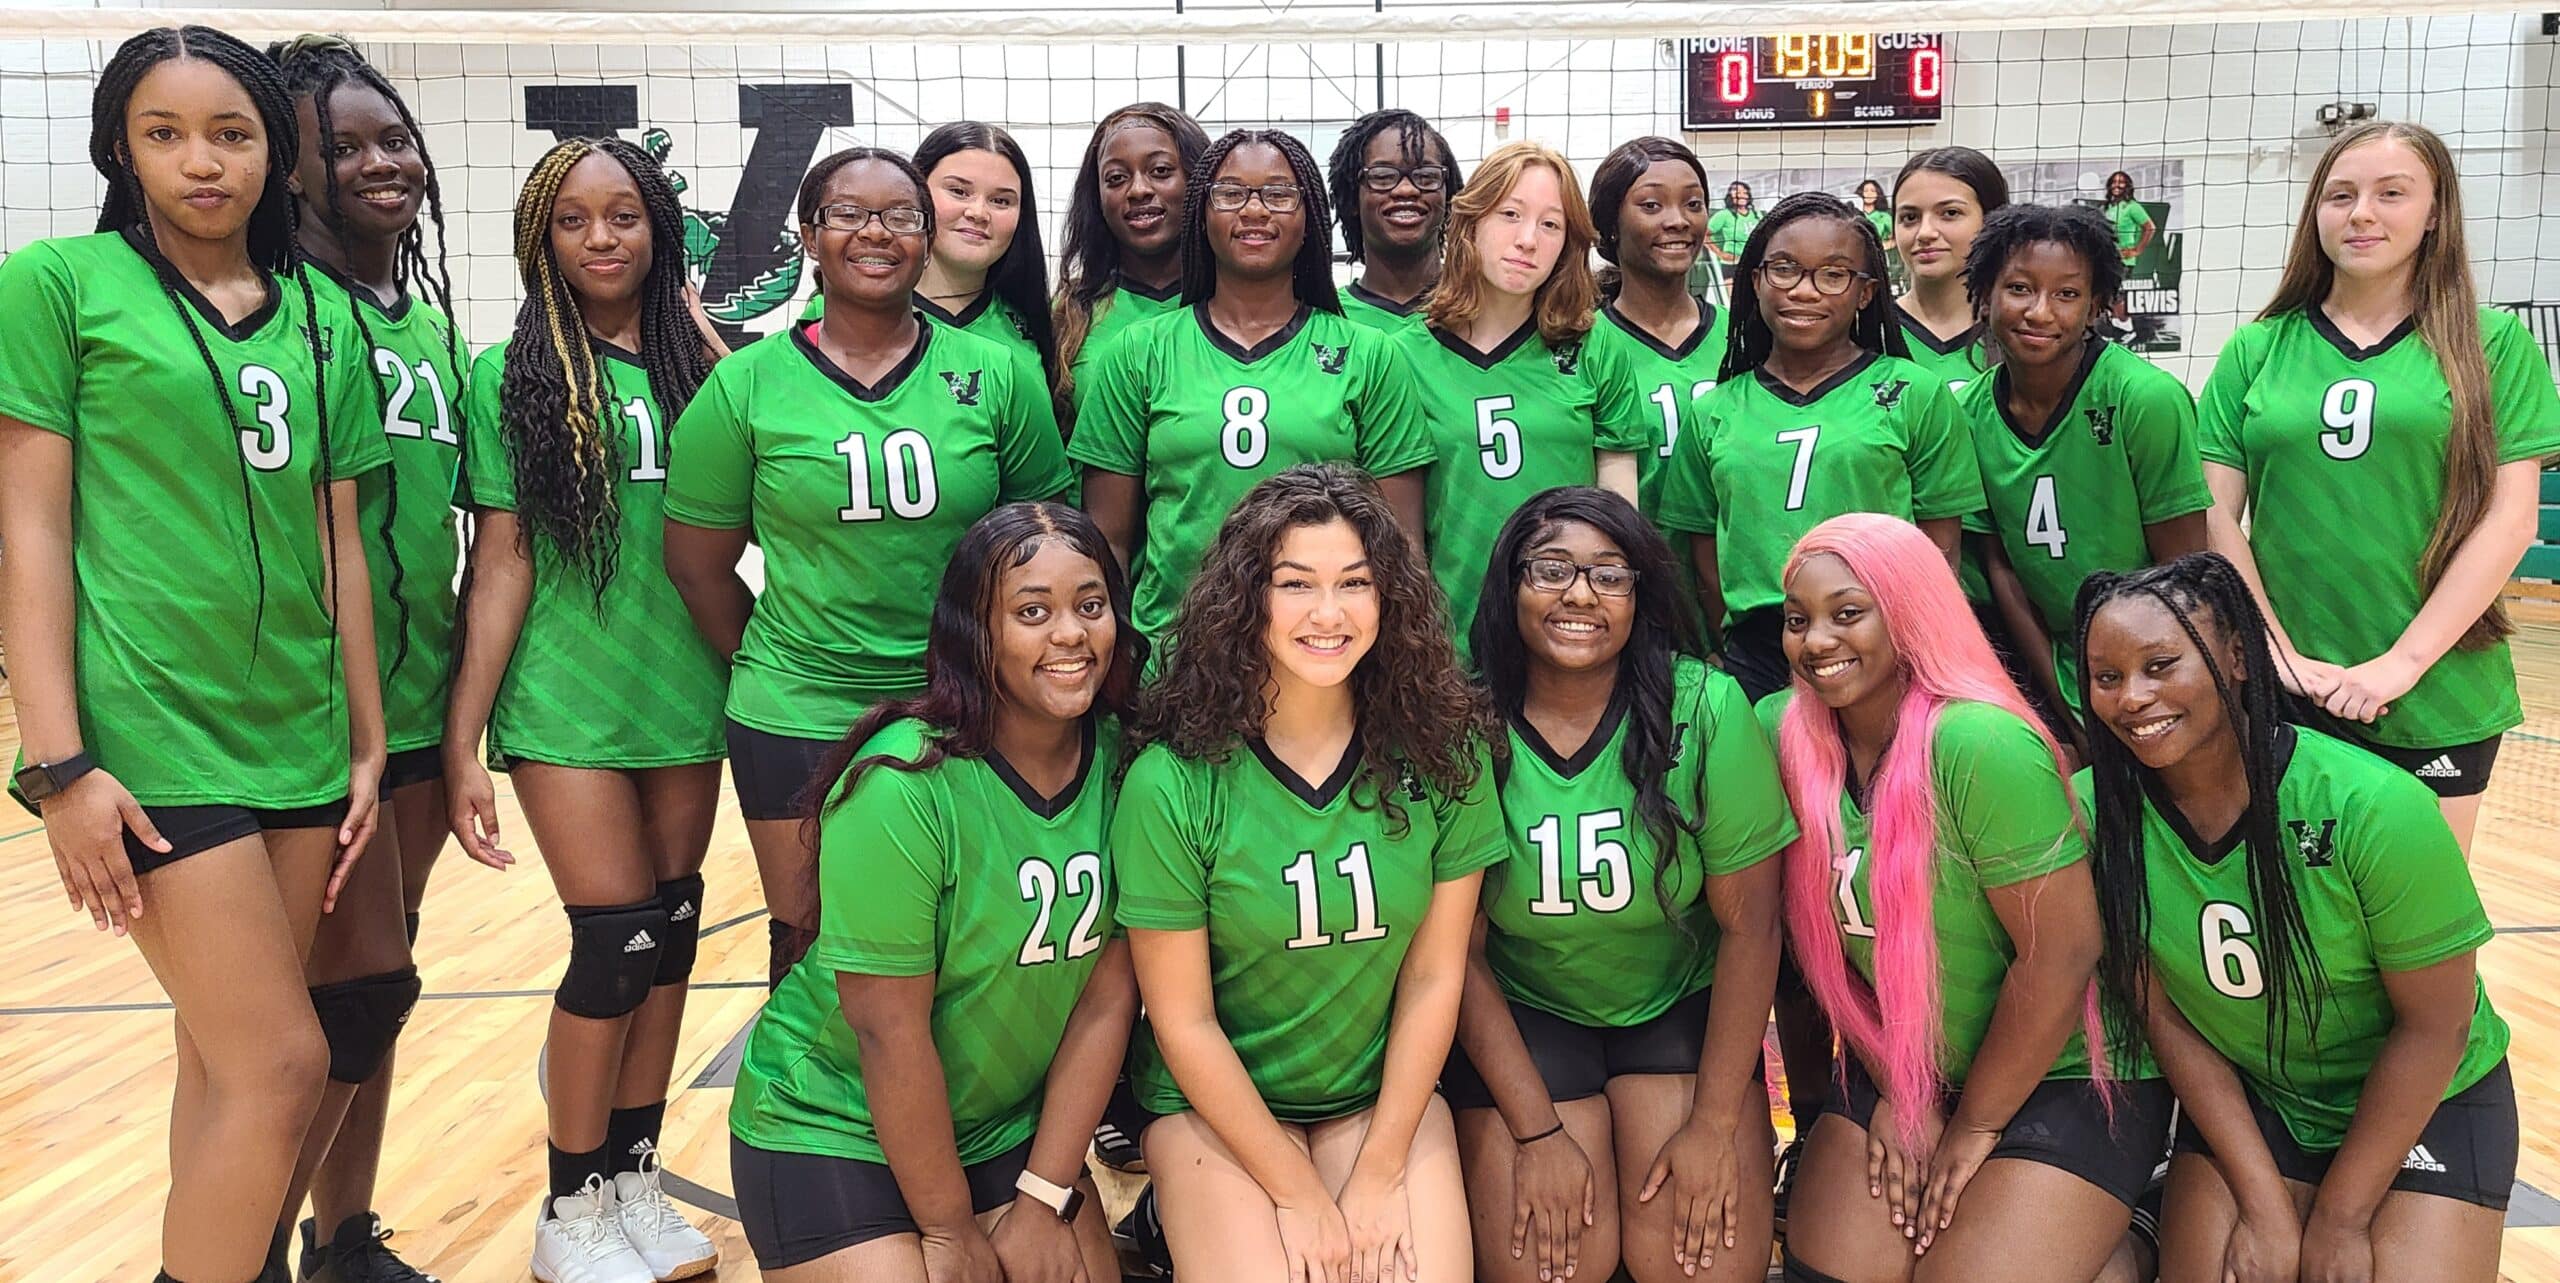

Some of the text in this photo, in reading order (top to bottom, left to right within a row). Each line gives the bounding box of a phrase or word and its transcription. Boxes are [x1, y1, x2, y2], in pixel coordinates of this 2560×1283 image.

[1690, 36, 1748, 53] HOME
[1720, 54, 1748, 102] 0
[1772, 32, 1872, 76] 19:09
[1878, 33, 1941, 50] GUEST
[1913, 50, 1940, 98] 0
[1795, 81, 1834, 90] PERIOD
[237, 363, 292, 472] 3
[373, 346, 459, 446] 21
[1220, 386, 1269, 469] 8
[1475, 395, 1524, 480] 5
[2318, 378, 2378, 461] 9
[834, 428, 940, 522] 10
[1776, 425, 1822, 511] 7
[2026, 475, 2069, 560] 4
[2415, 767, 2462, 777] adidas
[1284, 842, 1390, 950] 11
[1528, 809, 1635, 916] 15
[623, 940, 657, 953] adidas
[1015, 852, 1104, 966] 22
[2201, 902, 2264, 999] 6
[2401, 1159, 2447, 1172] didas
